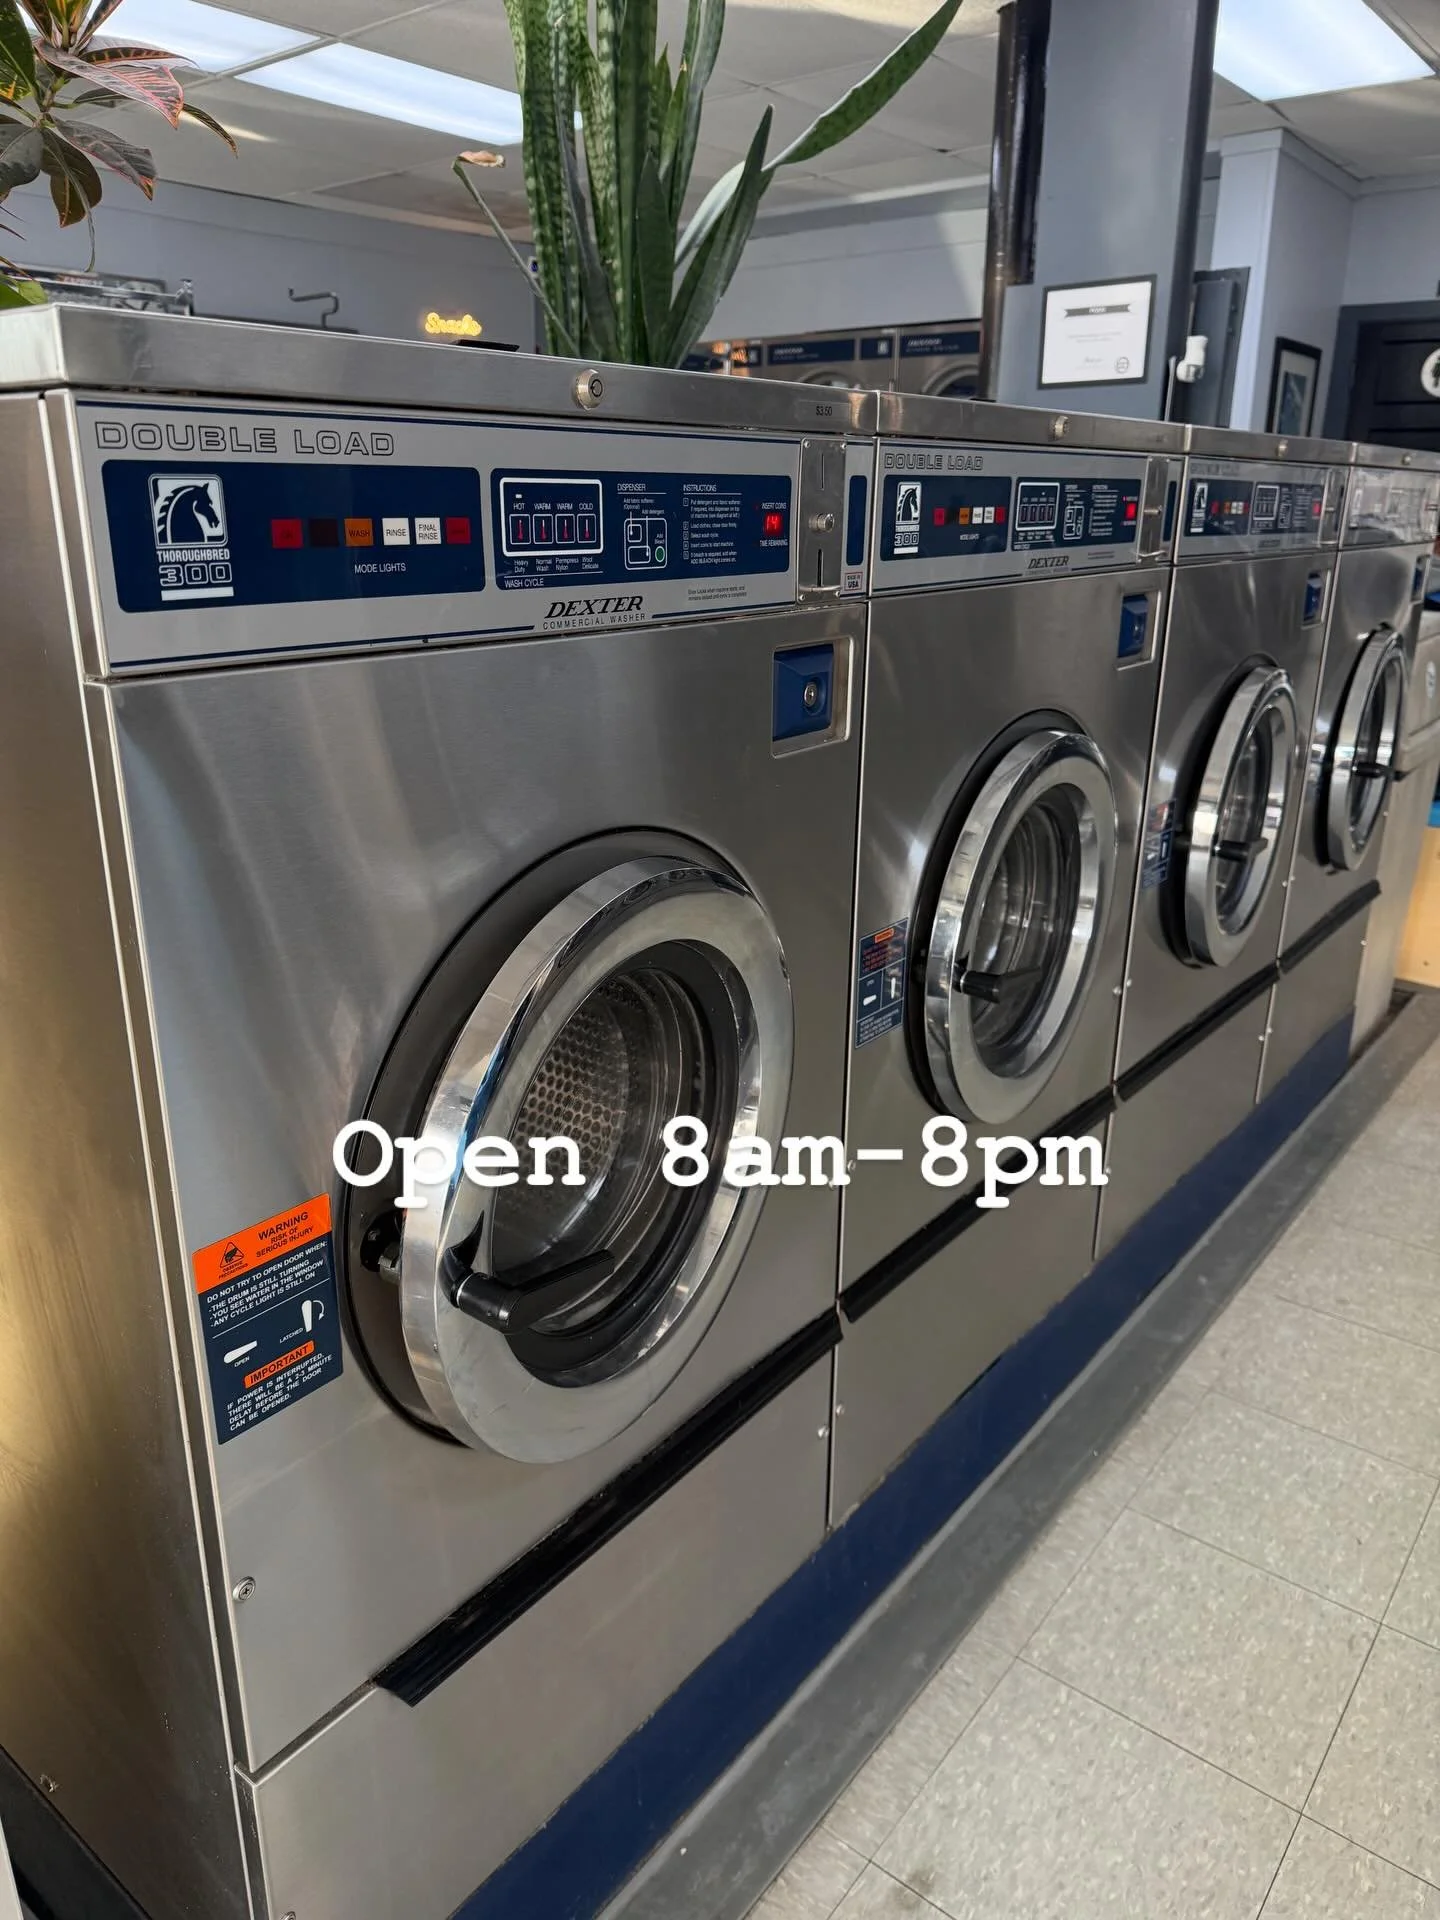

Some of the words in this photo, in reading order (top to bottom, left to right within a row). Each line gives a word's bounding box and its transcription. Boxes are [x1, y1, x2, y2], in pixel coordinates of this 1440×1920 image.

[95, 421, 277, 453] DOUBLE
[294, 429, 394, 456] LOAD
[884, 453, 943, 470] DOUBLE
[947, 455, 984, 470] LOAD
[616, 483, 647, 491] DISPENSER
[683, 484, 717, 492] INSTRUCTIONS
[534, 502, 551, 510] WARM
[556, 502, 574, 510] WARM
[579, 502, 594, 510] COLD
[349, 529, 370, 537] WASH
[385, 529, 406, 537] RINSE
[418, 524, 437, 532] FINAL
[418, 531, 438, 540] RINSE
[894, 532, 920, 547] 300
[157, 548, 231, 563] THOROUGHBRED
[1028, 555, 1070, 569] DEXTER
[159, 562, 233, 587] 300
[353, 563, 378, 574] MODE
[380, 561, 408, 572] LIGHTS
[504, 578, 523, 588] WASH
[524, 577, 545, 587] CYCLE
[544, 595, 644, 619] DEXTER
[543, 617, 606, 630] COMMERCIAL
[609, 613, 646, 624] WASHER
[258, 1211, 309, 1240] WARNING
[256, 1239, 288, 1258] SERIOUS
[288, 1225, 313, 1244] INJURY
[270, 1231, 289, 1244] RISK
[289, 1226, 299, 1236] OF
[207, 1293, 218, 1304] DO
[219, 1285, 237, 1297] NOT
[236, 1277, 252, 1290] TRY
[252, 1272, 263, 1283] TO
[263, 1262, 283, 1278] OPEN
[283, 1251, 305, 1267] DOOR
[304, 1241, 329, 1257] WHEN:
[227, 1288, 250, 1305] DRUM
[250, 1284, 258, 1294] IS
[259, 1275, 278, 1290] STILL
[279, 1259, 310, 1280] TURNING
[230, 1298, 245, 1311] SEE
[246, 1287, 270, 1304] WATER
[271, 1283, 280, 1292] IN
[280, 1275, 294, 1288] THE
[294, 1260, 324, 1280] WINDOW
[230, 1303, 255, 1318] CYCLE
[255, 1291, 276, 1306] LIGHT
[277, 1287, 285, 1296] IS
[285, 1279, 304, 1292] STILL
[305, 1271, 315, 1281] ON
[279, 1327, 304, 1343] LATCHED
[234, 1356, 250, 1368] OPEN
[250, 1345, 309, 1385] IMPORTANT
[228, 1400, 252, 1417] THERE
[255, 1391, 272, 1404] WILL
[274, 1382, 285, 1392] BE
[295, 1370, 305, 1381] 2-3
[307, 1354, 332, 1372] MINUTE
[227, 1402, 234, 1411] IF
[237, 1386, 263, 1404] POWER
[266, 1380, 274, 1389] IS
[229, 1408, 253, 1425] DELAY
[255, 1390, 285, 1408] BEFORE
[286, 1380, 300, 1391] THE
[302, 1367, 322, 1384] DOOR
[230, 1419, 246, 1432] CAN
[248, 1411, 259, 1421] BE
[261, 1394, 290, 1413] OPENED.
